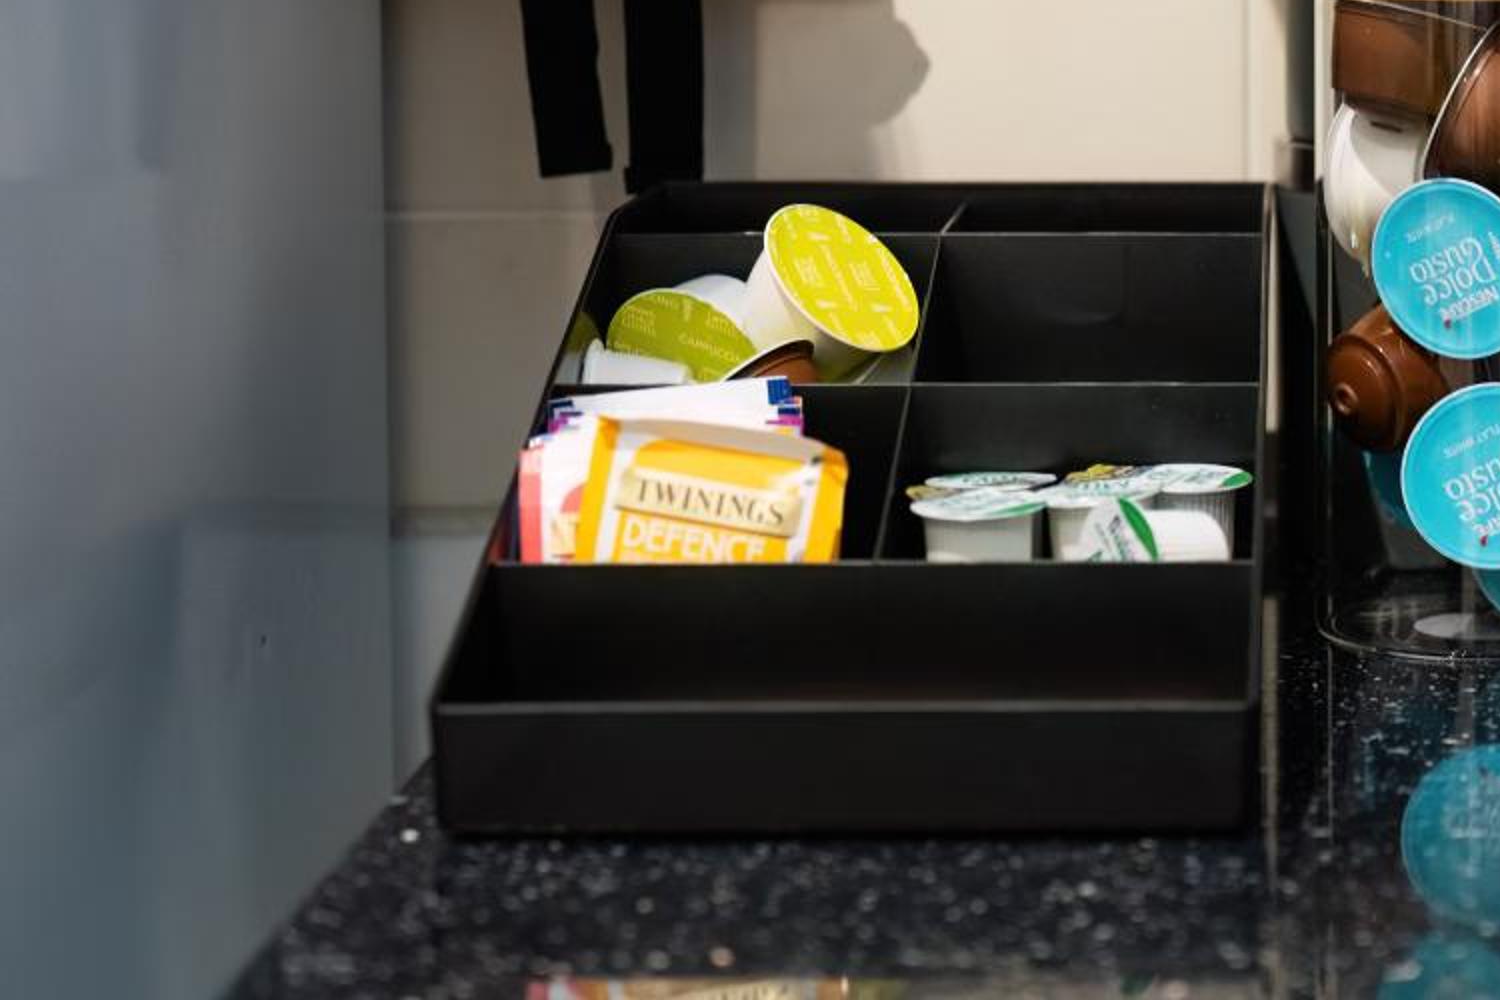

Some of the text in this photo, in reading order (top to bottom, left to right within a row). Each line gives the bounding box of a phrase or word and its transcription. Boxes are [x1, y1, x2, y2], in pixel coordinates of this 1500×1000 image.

[1408, 236, 1485, 284] Gusto
[1420, 257, 1497, 307] Dolce
[635, 479, 786, 527] TWININGS
[621, 516, 766, 562] DEFENCE
